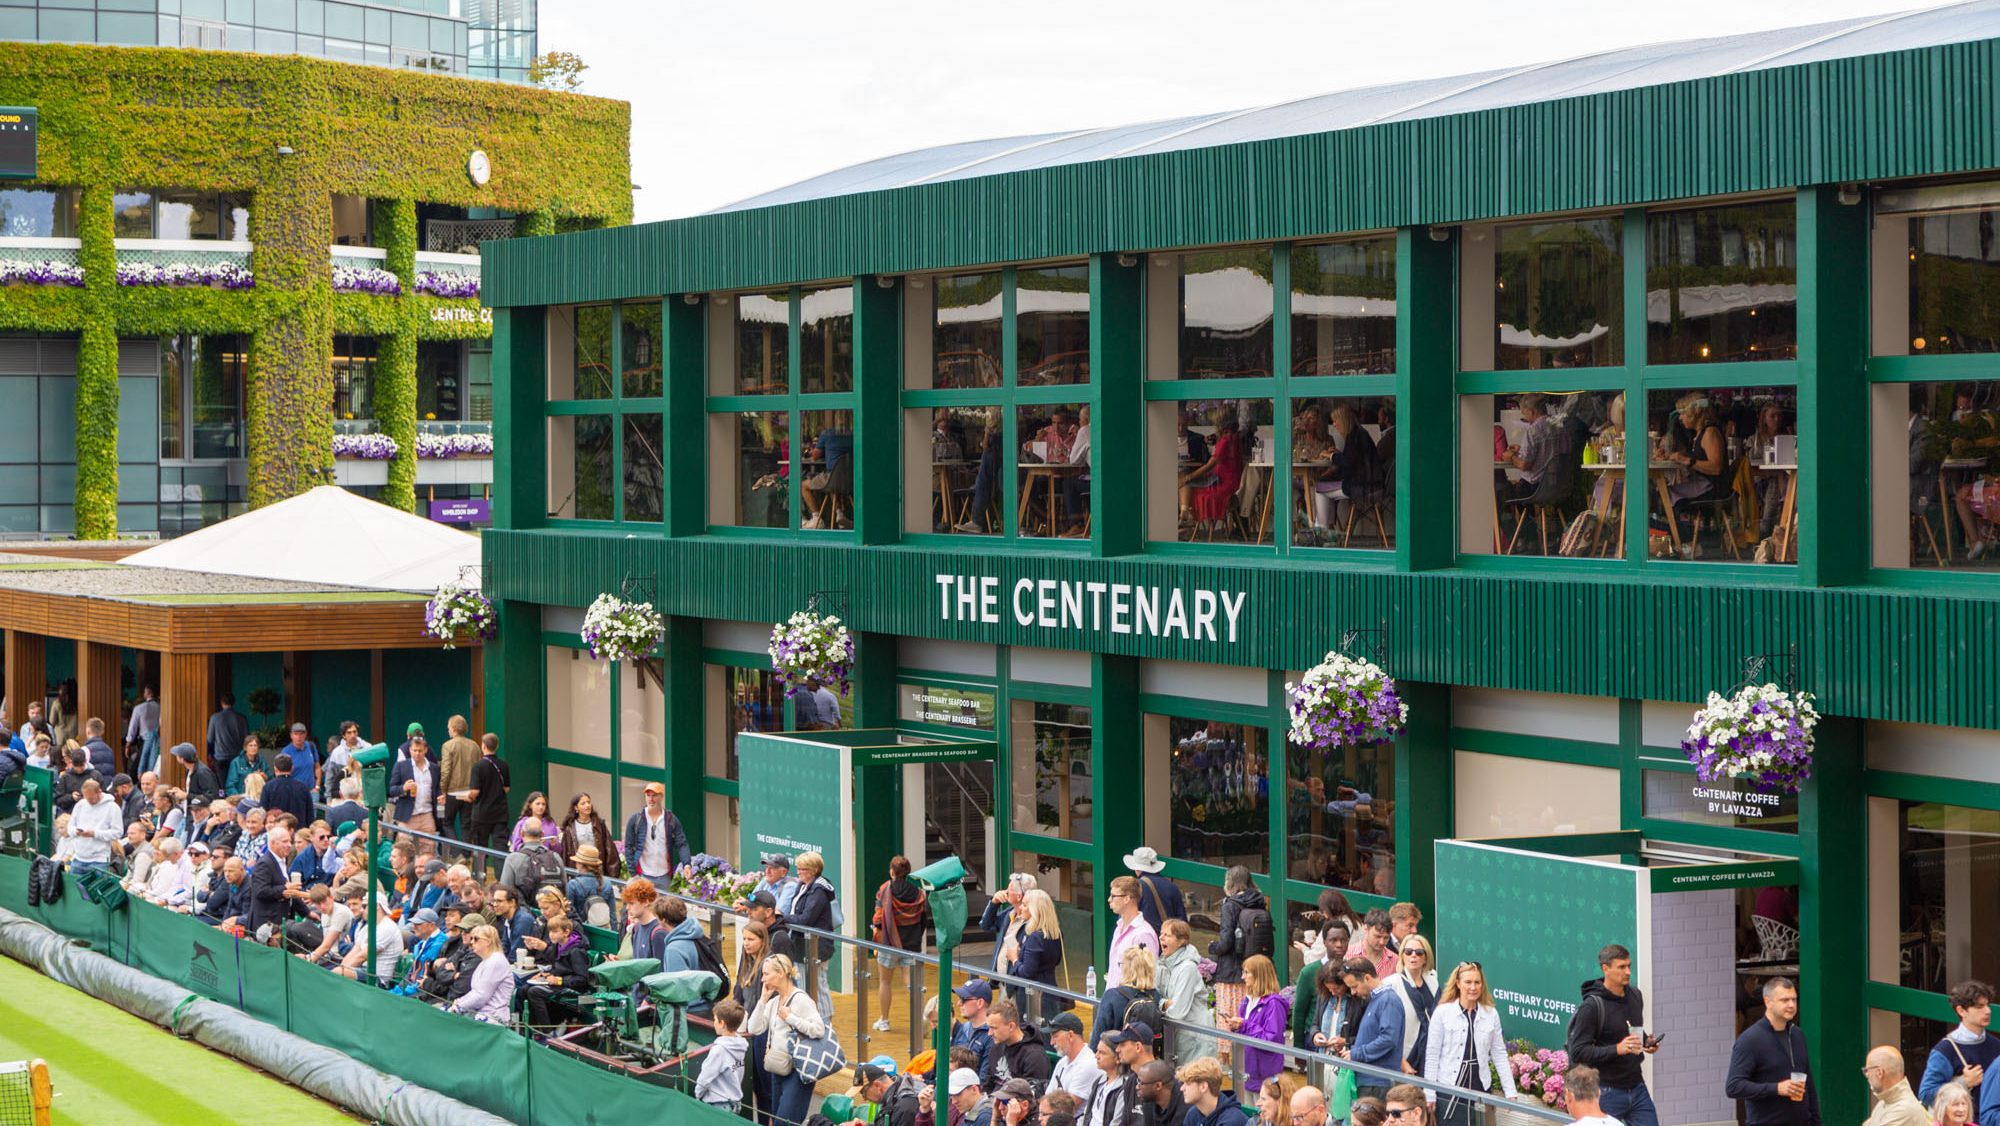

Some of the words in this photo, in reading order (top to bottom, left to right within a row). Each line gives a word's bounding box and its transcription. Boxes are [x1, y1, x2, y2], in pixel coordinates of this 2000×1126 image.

[430, 307, 475, 323] CENTRE
[936, 574, 999, 624] THE
[1013, 577, 1247, 643] CENTENARY
[912, 693, 921, 702] THE
[921, 694, 947, 705] CENTENARY
[948, 697, 970, 708] SEAFOOD
[970, 700, 980, 709] BAR
[916, 711, 925, 719] THE
[925, 711, 951, 722] CENTENARY
[951, 715, 977, 725] BRASSERIE
[1692, 787, 1743, 802] CENTENARY
[1745, 792, 1780, 806] COFFEE
[1708, 802, 1720, 813] BY
[1722, 803, 1763, 818] LAVAZZA
[757, 833, 765, 843] THE
[765, 836, 791, 847] CENTENARY
[791, 841, 812, 851] SEAFOOD
[812, 844, 822, 853] BAR
[1672, 875, 1710, 883] CENTENARY
[1711, 873, 1736, 881] COFFEE
[1747, 871, 1775, 879] LAVAZZA
[1493, 988, 1541, 1007] CENTENARY
[1543, 998, 1576, 1014] COFFEE
[1508, 1005, 1520, 1016] BY
[1521, 1007, 1561, 1025] LAVAZZA
